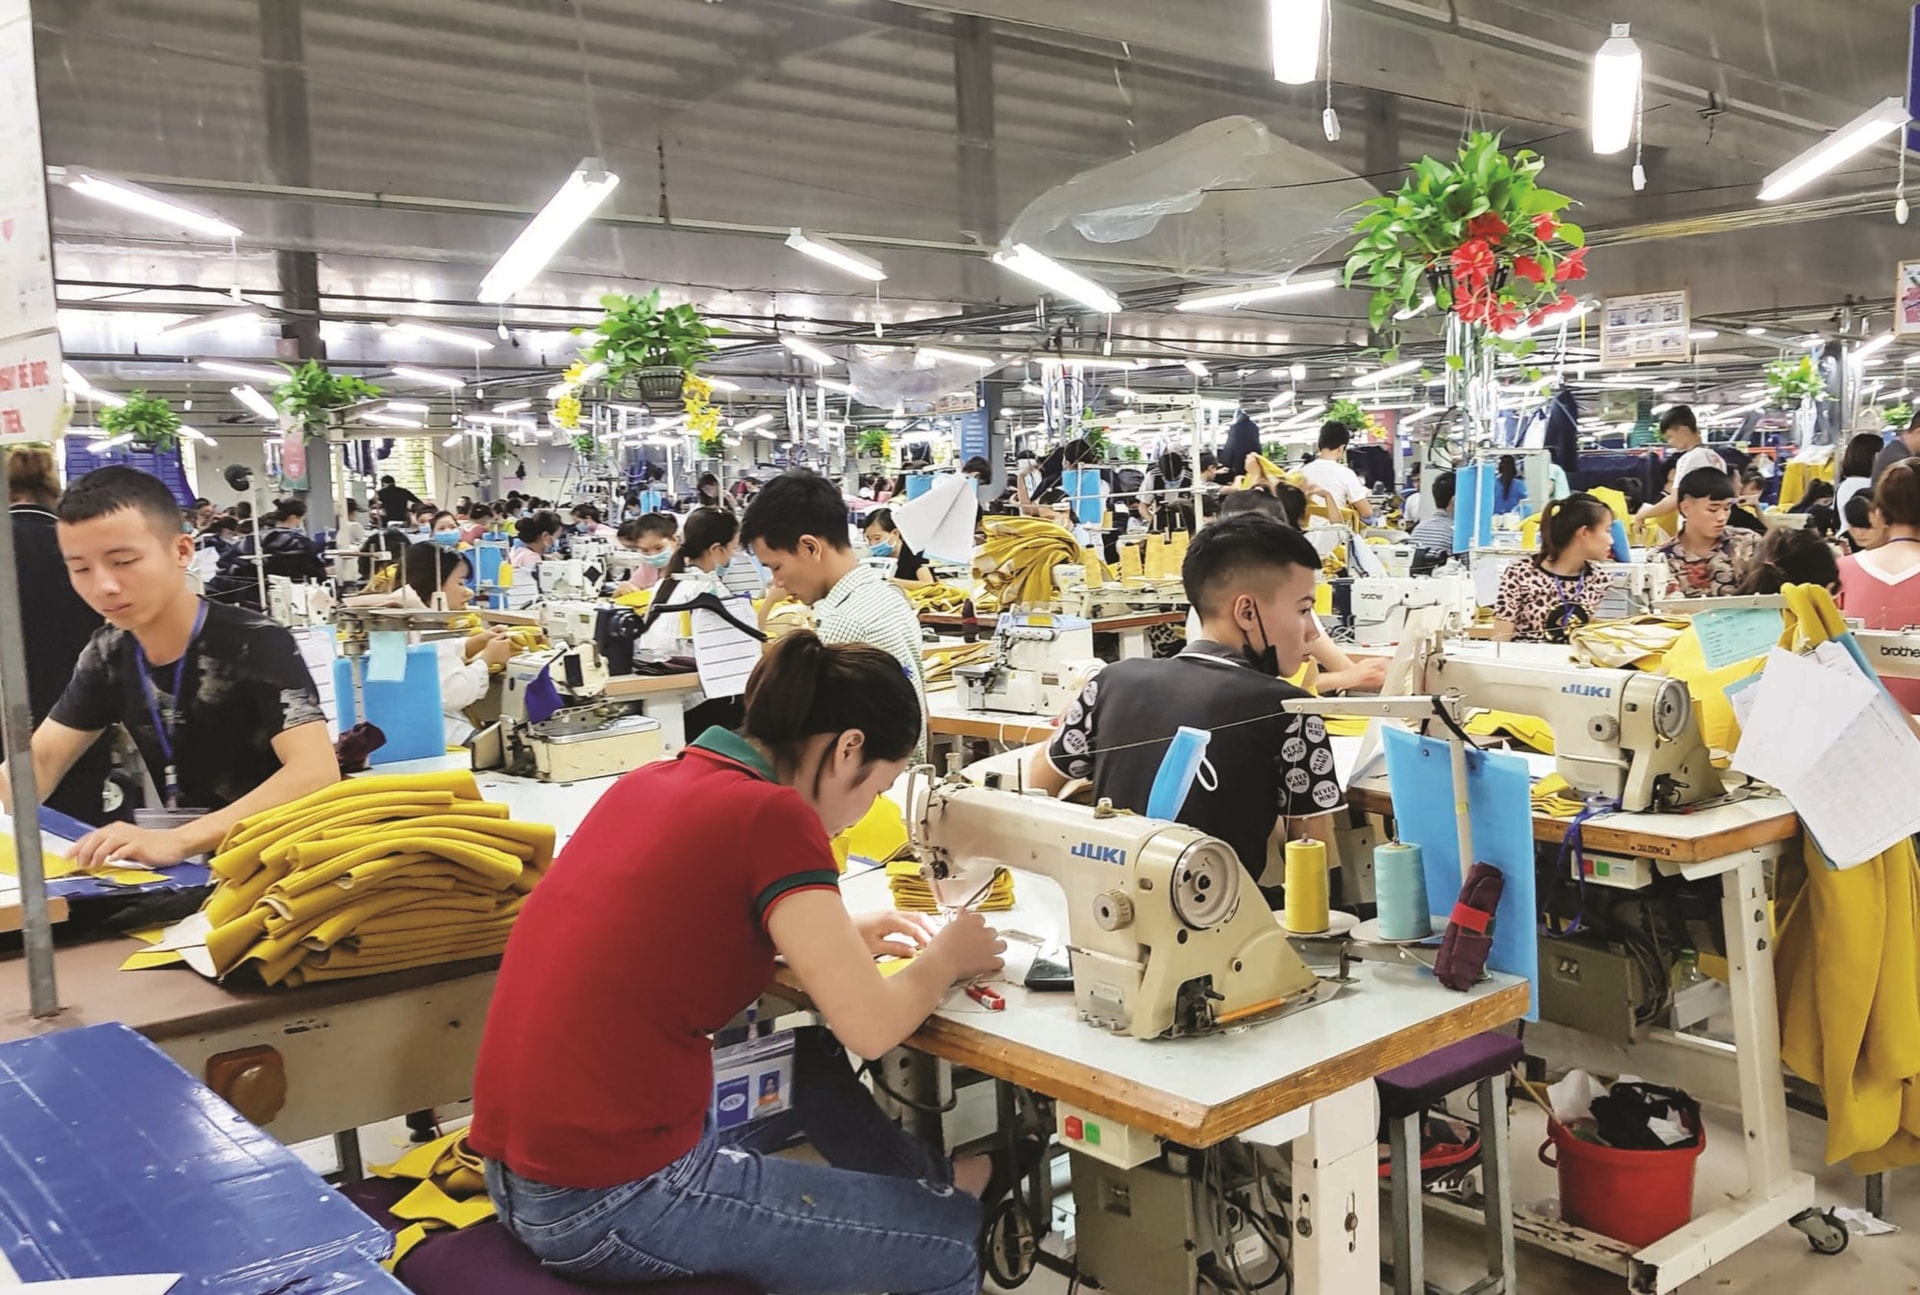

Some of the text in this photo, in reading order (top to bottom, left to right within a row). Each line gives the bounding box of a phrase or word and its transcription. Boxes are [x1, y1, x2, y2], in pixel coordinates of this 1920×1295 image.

[1561, 684, 1611, 698] JUKI
[1313, 785, 1337, 798] NEVER
[1318, 791, 1336, 803] MIND
[1071, 842, 1126, 866] JUKI
